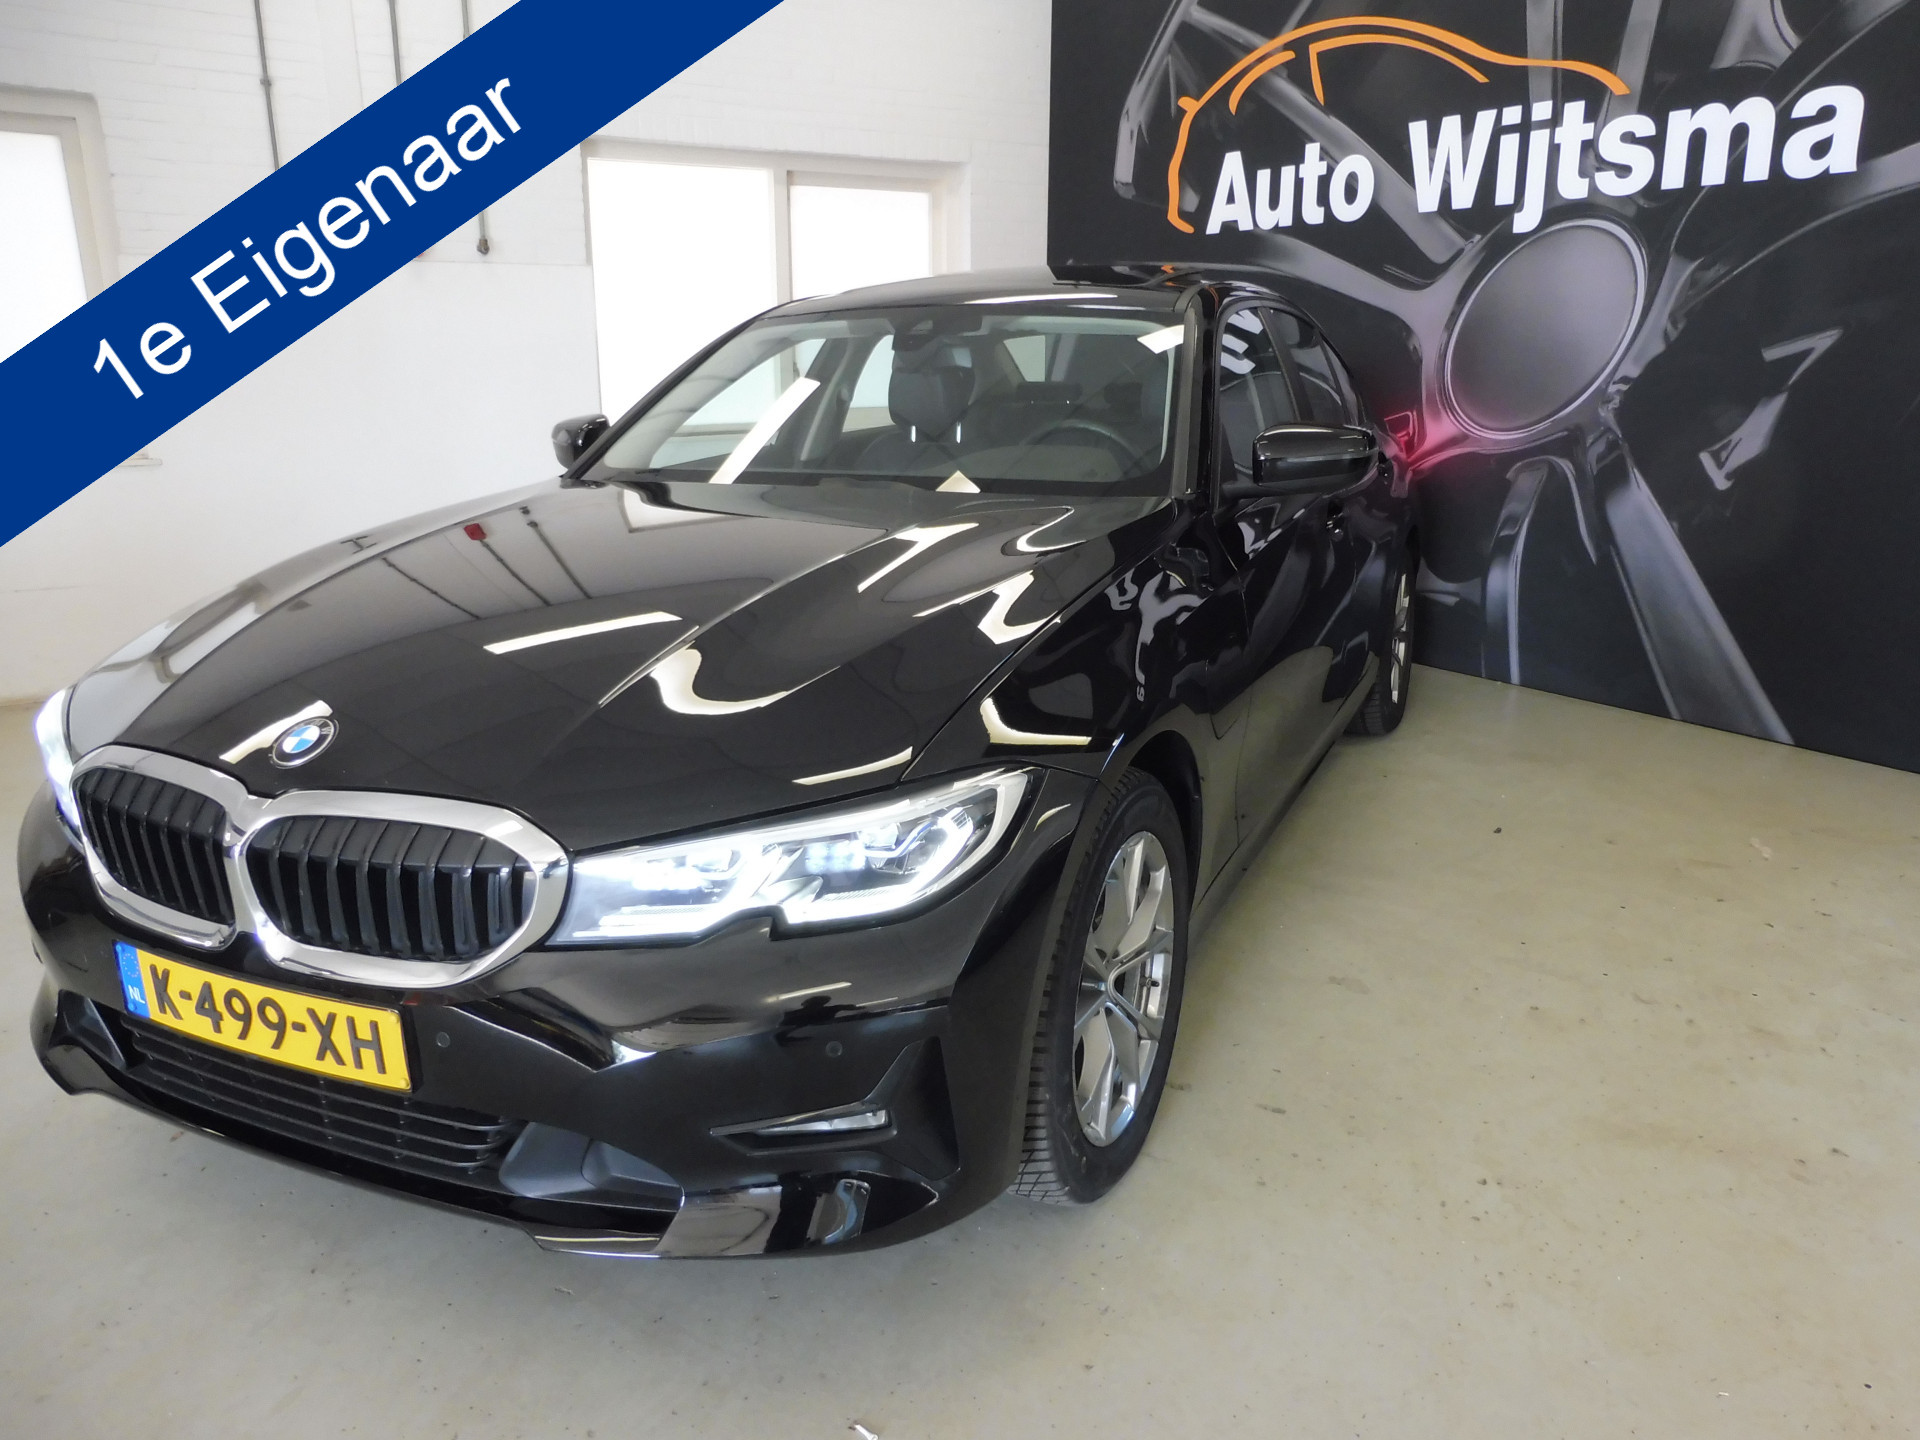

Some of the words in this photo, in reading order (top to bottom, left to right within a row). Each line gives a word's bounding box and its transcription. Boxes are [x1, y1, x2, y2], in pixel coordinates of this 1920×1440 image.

[1205, 142, 1376, 235] Auto
[1408, 85, 1866, 234] Wijtsma
[128, 984, 146, 1004] NL
[149, 964, 388, 1075] K-499-XH
